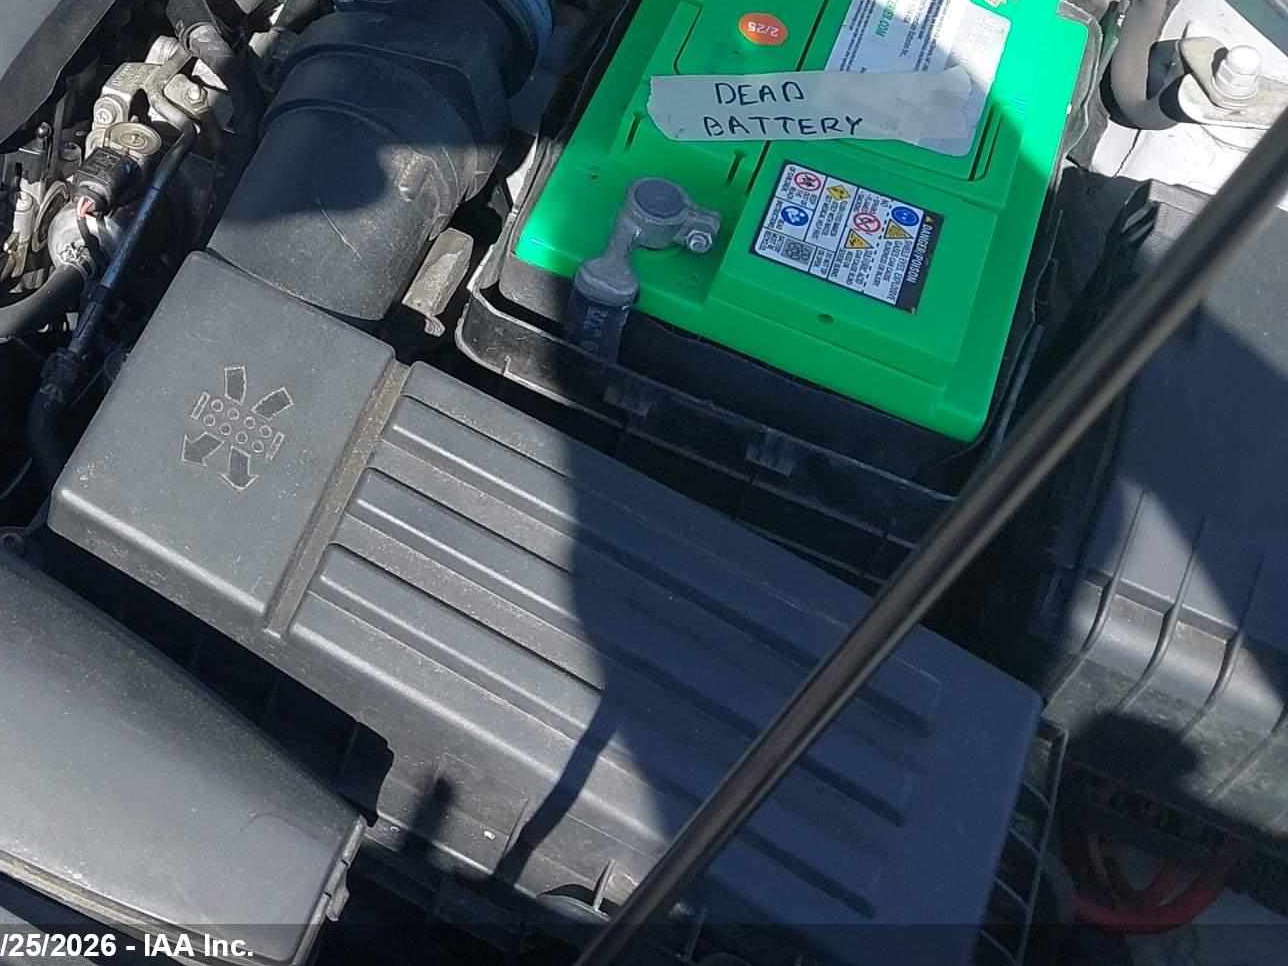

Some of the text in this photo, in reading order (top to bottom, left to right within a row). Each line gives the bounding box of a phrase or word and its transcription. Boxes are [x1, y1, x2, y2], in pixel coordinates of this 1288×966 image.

[748, 21, 779, 37] 2/25
[714, 81, 804, 106] DEAD
[703, 115, 864, 136] BATTERY
[890, 240, 902, 257] GASES
[899, 239, 912, 258] SHIELD
[905, 223, 933, 283] DANGER/POISON
[887, 257, 897, 267] CAN
[885, 271, 901, 301] EXPLOSIVE
